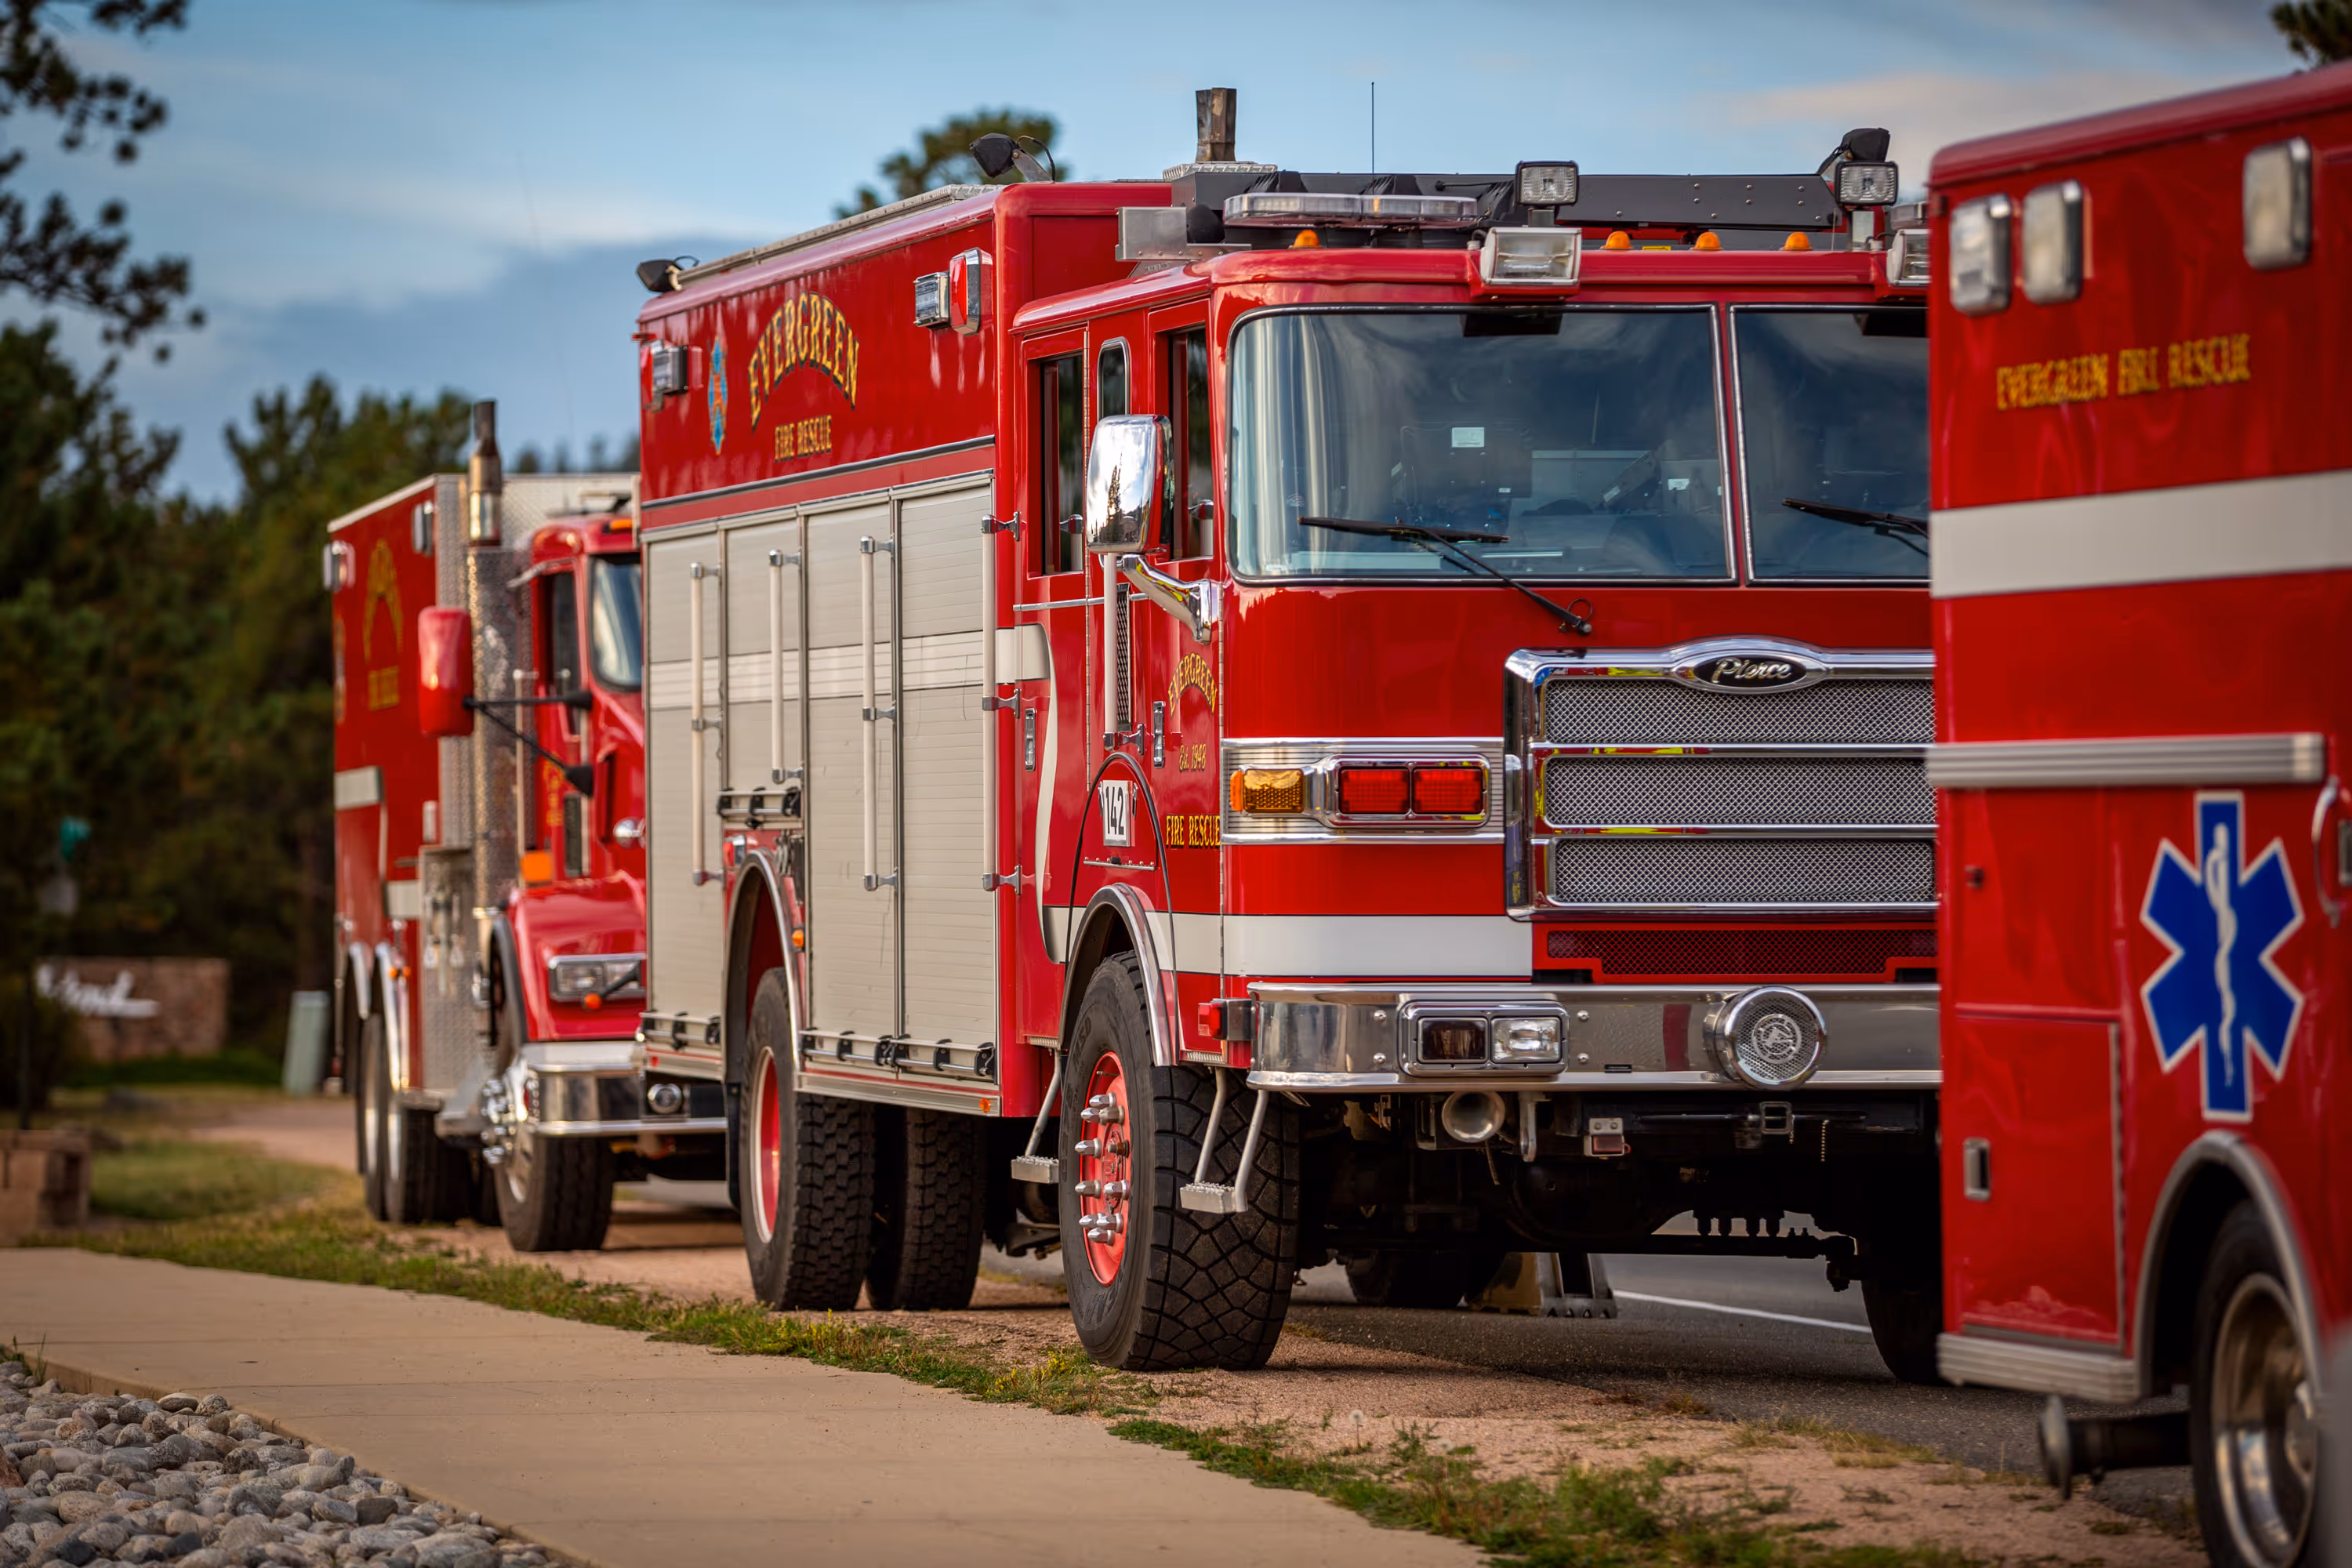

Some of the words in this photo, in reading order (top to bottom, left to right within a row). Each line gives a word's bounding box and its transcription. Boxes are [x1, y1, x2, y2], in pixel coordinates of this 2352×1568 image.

[747, 291, 859, 434] EVERGREEN
[774, 423, 795, 463] FIRE
[797, 413, 832, 459] RESCUE
[1167, 652, 1218, 718] EVERGREEN
[1711, 657, 1792, 684] Pierce
[1191, 742, 1207, 771] 1948
[1105, 786, 1124, 836] 142
[1166, 815, 1185, 848] FIRE
[1189, 815, 1221, 849] RESCUE
